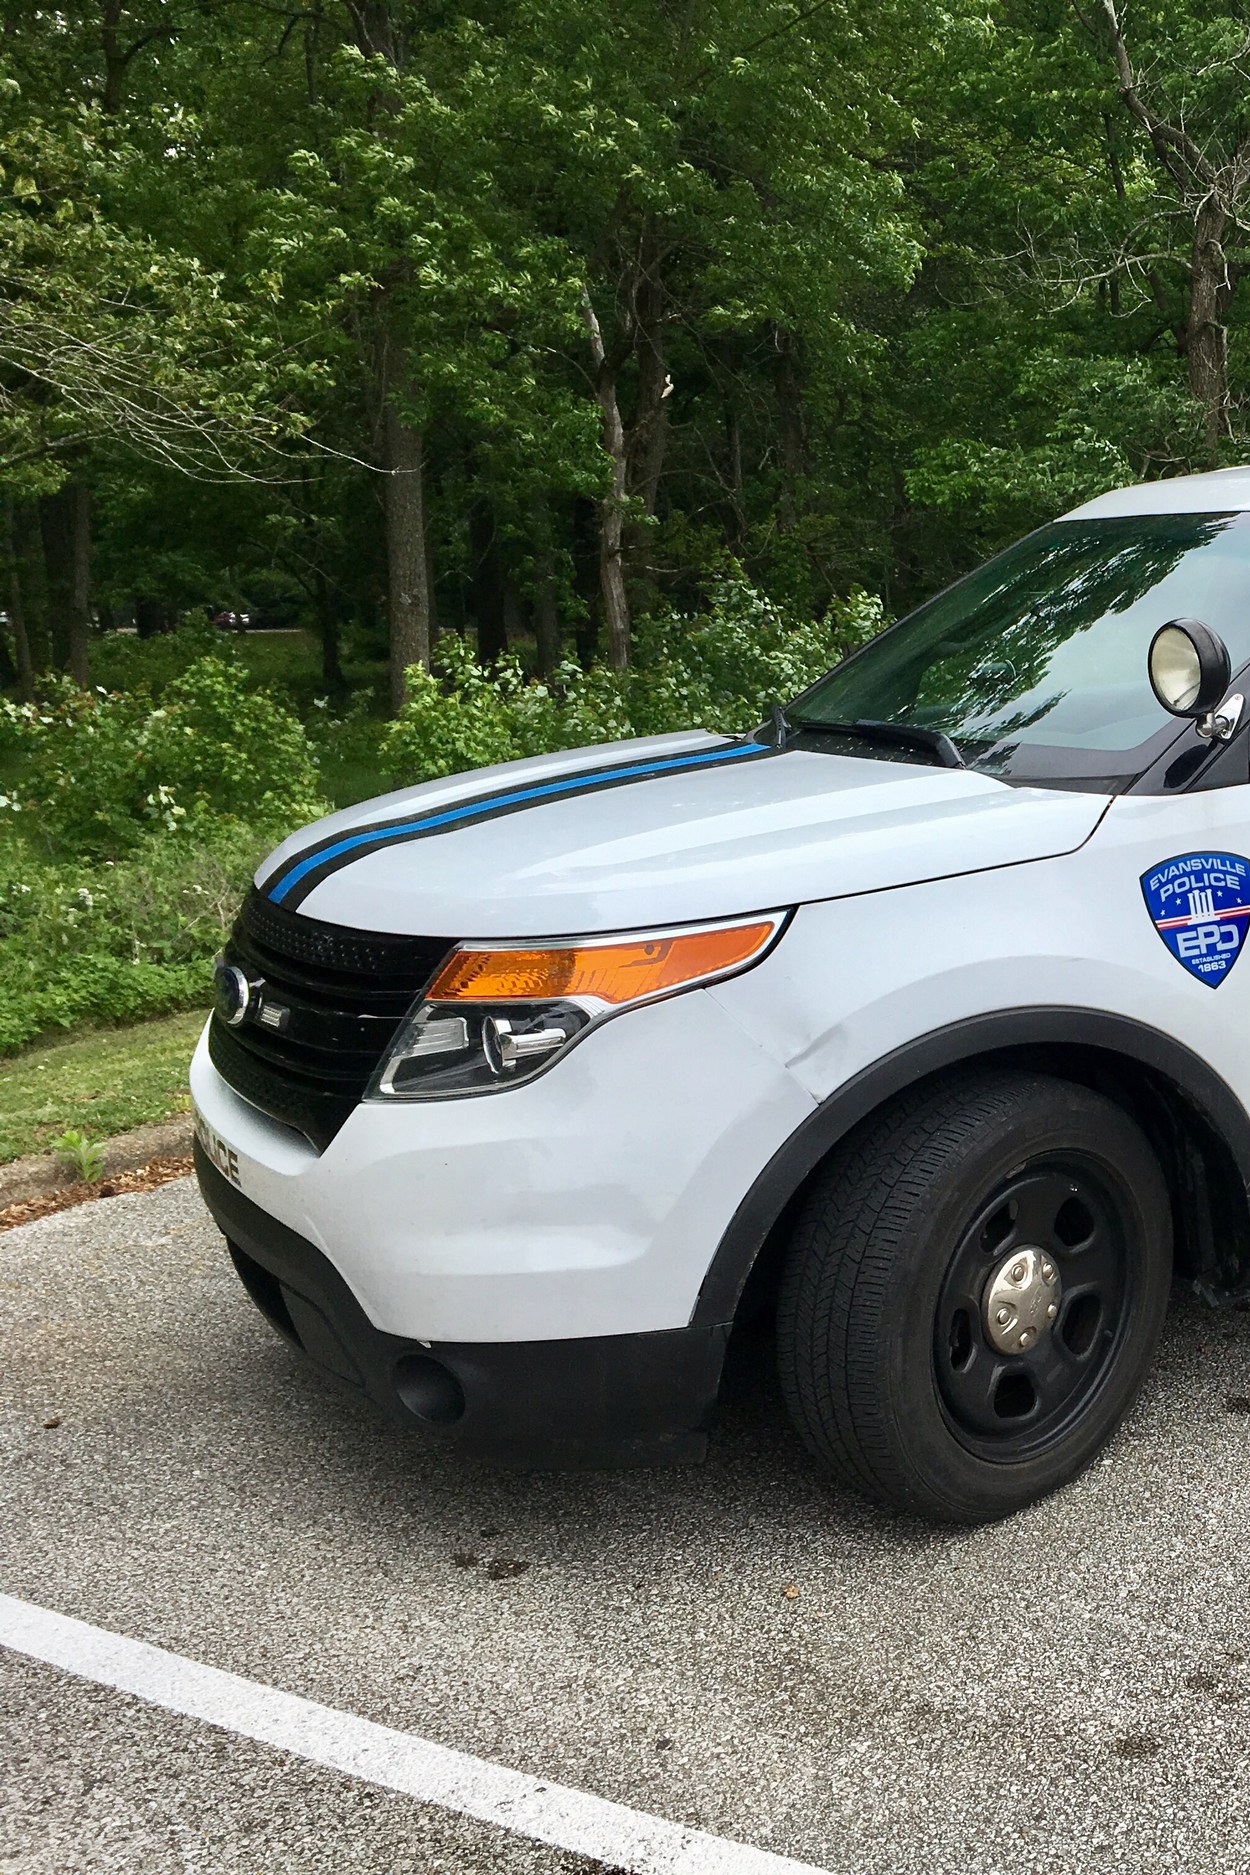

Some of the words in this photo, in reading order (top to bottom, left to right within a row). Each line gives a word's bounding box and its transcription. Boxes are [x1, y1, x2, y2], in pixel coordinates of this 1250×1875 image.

[1150, 858, 1246, 891] EVANSVILLE
[1160, 873, 1241, 902] POLICE
[1176, 924, 1240, 958] EPD
[1198, 960, 1226, 973] 1863
